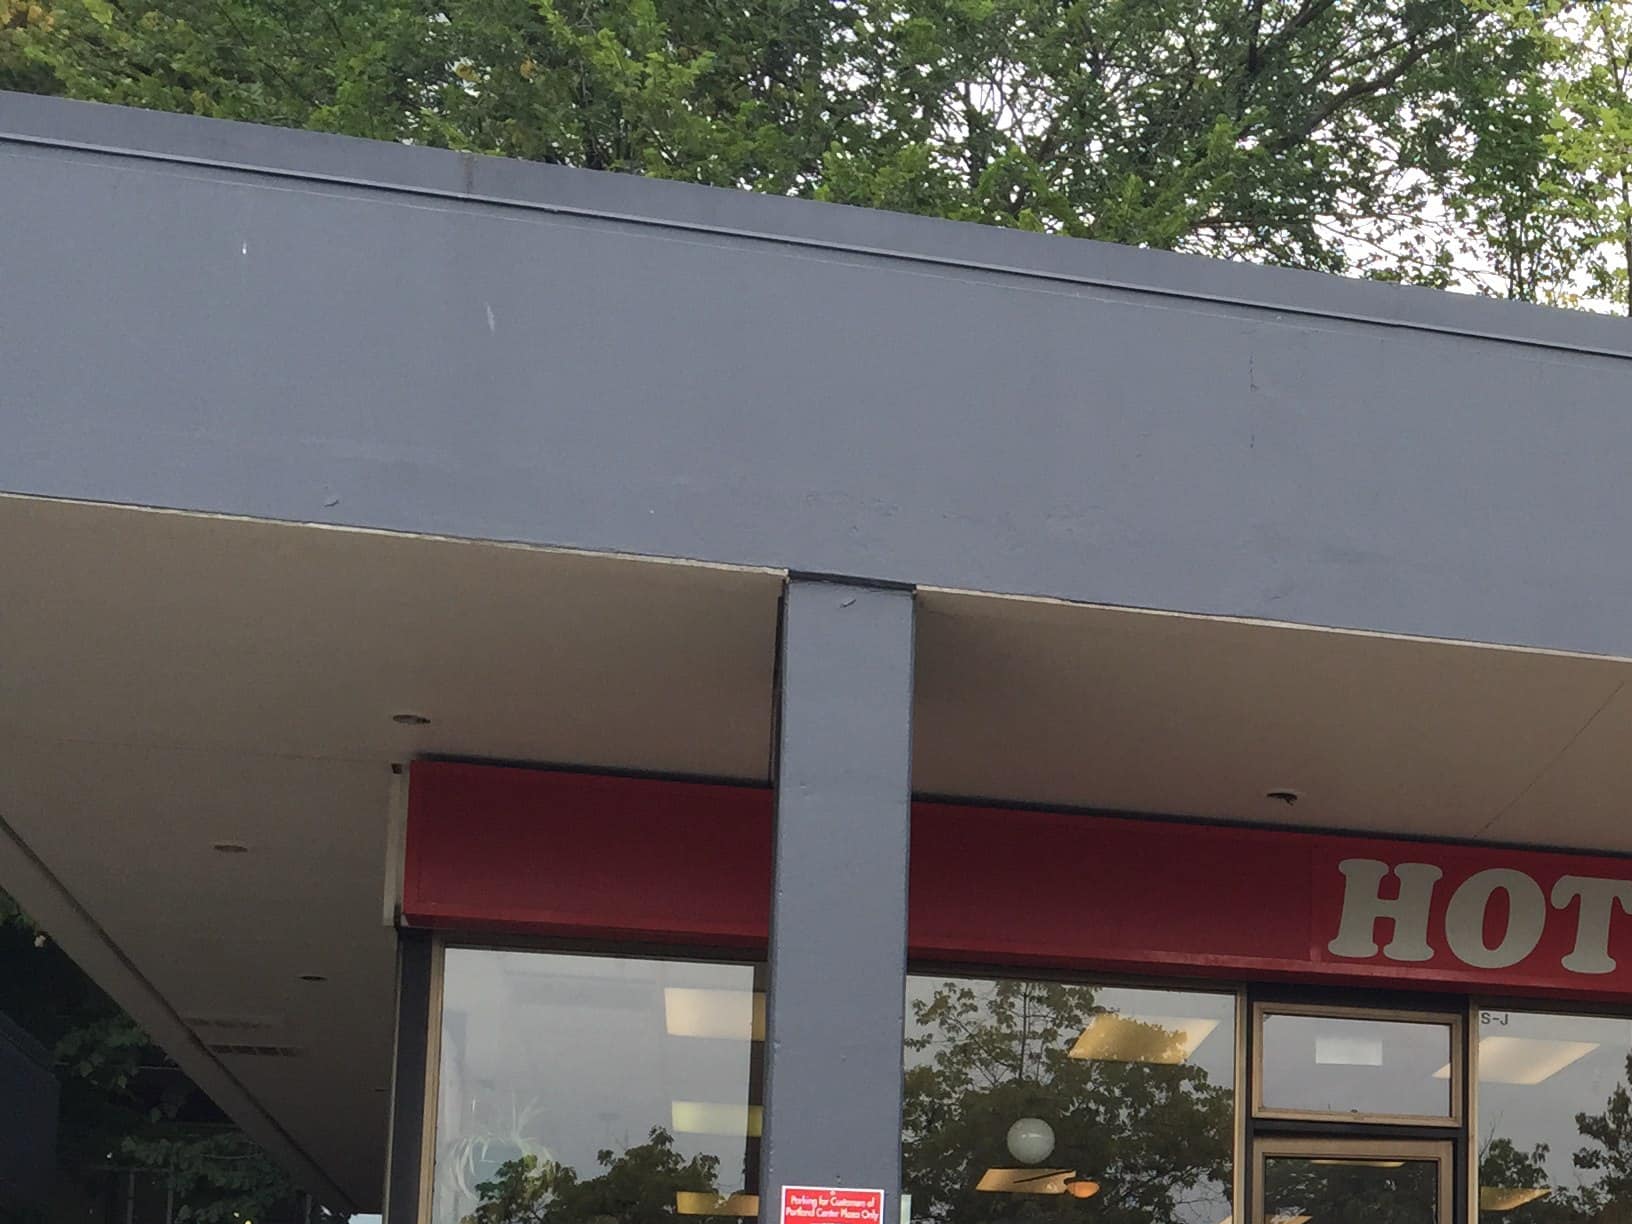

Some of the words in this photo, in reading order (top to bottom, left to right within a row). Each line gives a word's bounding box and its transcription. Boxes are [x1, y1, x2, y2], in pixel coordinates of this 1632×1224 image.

[790, 1195, 817, 1207] Parking
[819, 1196, 828, 1206] for
[861, 1209, 880, 1221] Only
